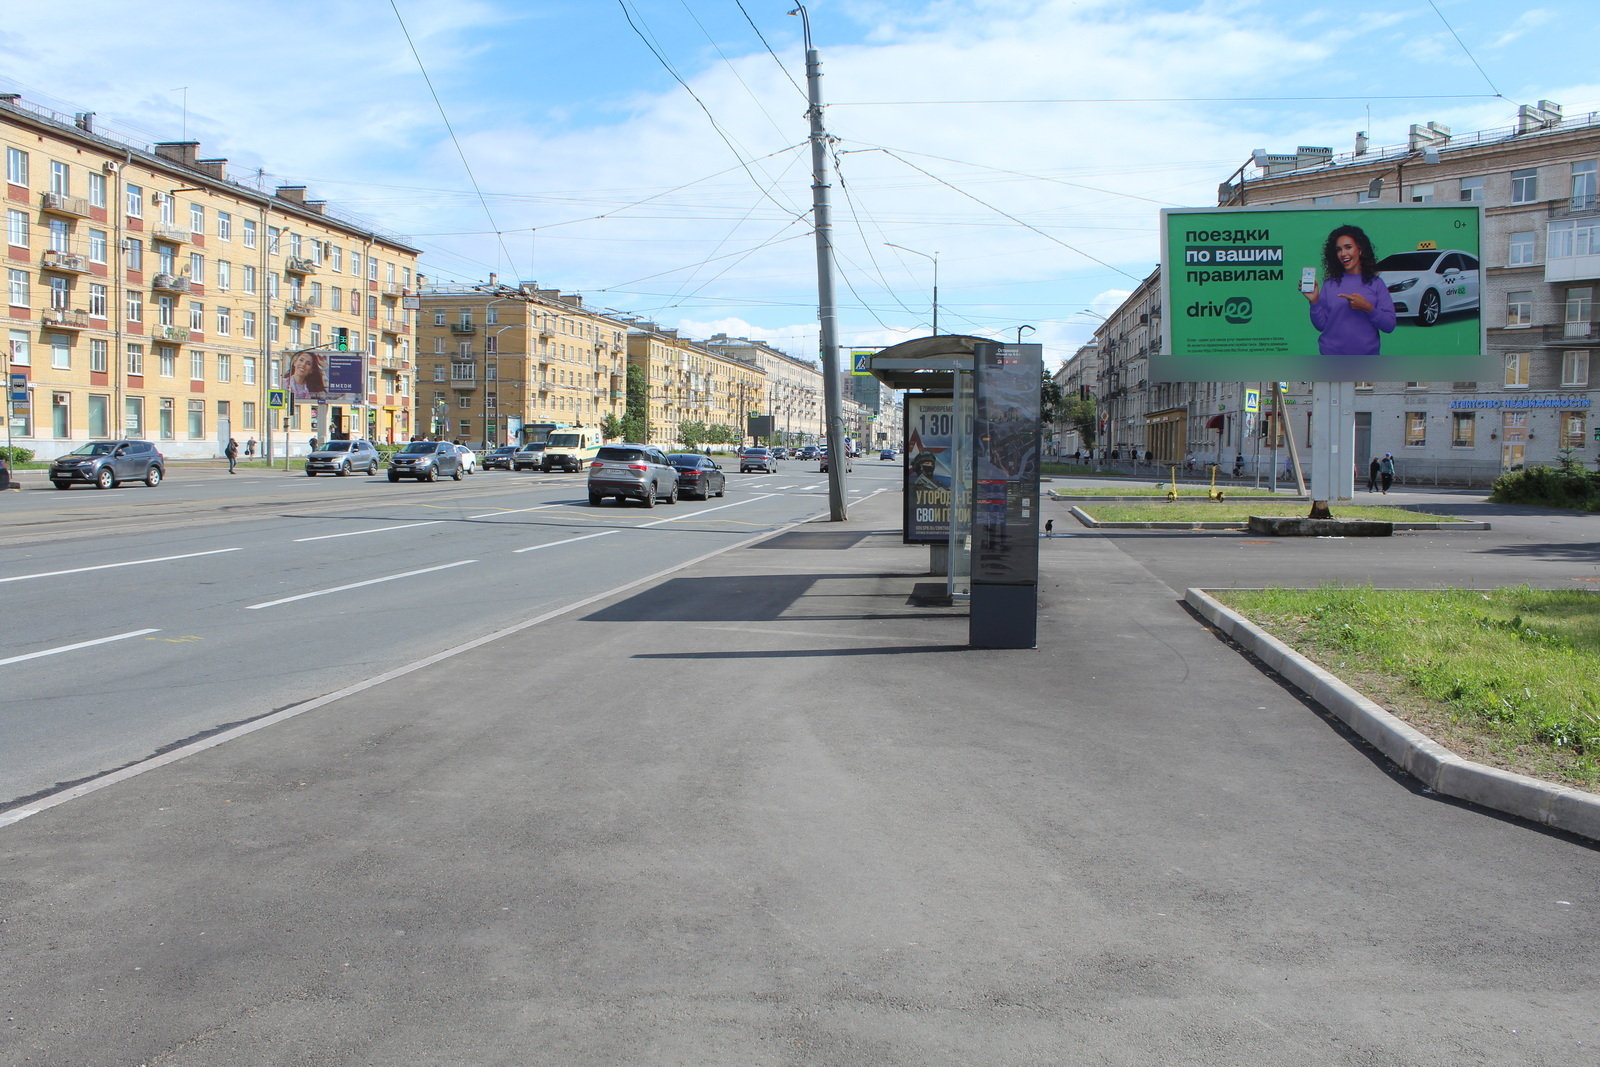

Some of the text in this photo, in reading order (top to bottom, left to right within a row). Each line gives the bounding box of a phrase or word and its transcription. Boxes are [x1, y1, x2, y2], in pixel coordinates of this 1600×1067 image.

[1454, 220, 1467, 229] 0+
[1186, 229, 1270, 244] поездки
[1186, 248, 1282, 263] по вашим
[1186, 269, 1284, 286] правилам
[1186, 299, 1253, 322] drivee
[1449, 398, 1591, 409] АГЕНТСТВО НЕДВИЖИМОСТИ
[920, 414, 925, 436] 1
[916, 490, 922, 505] У
[916, 507, 941, 522] СВОИ
